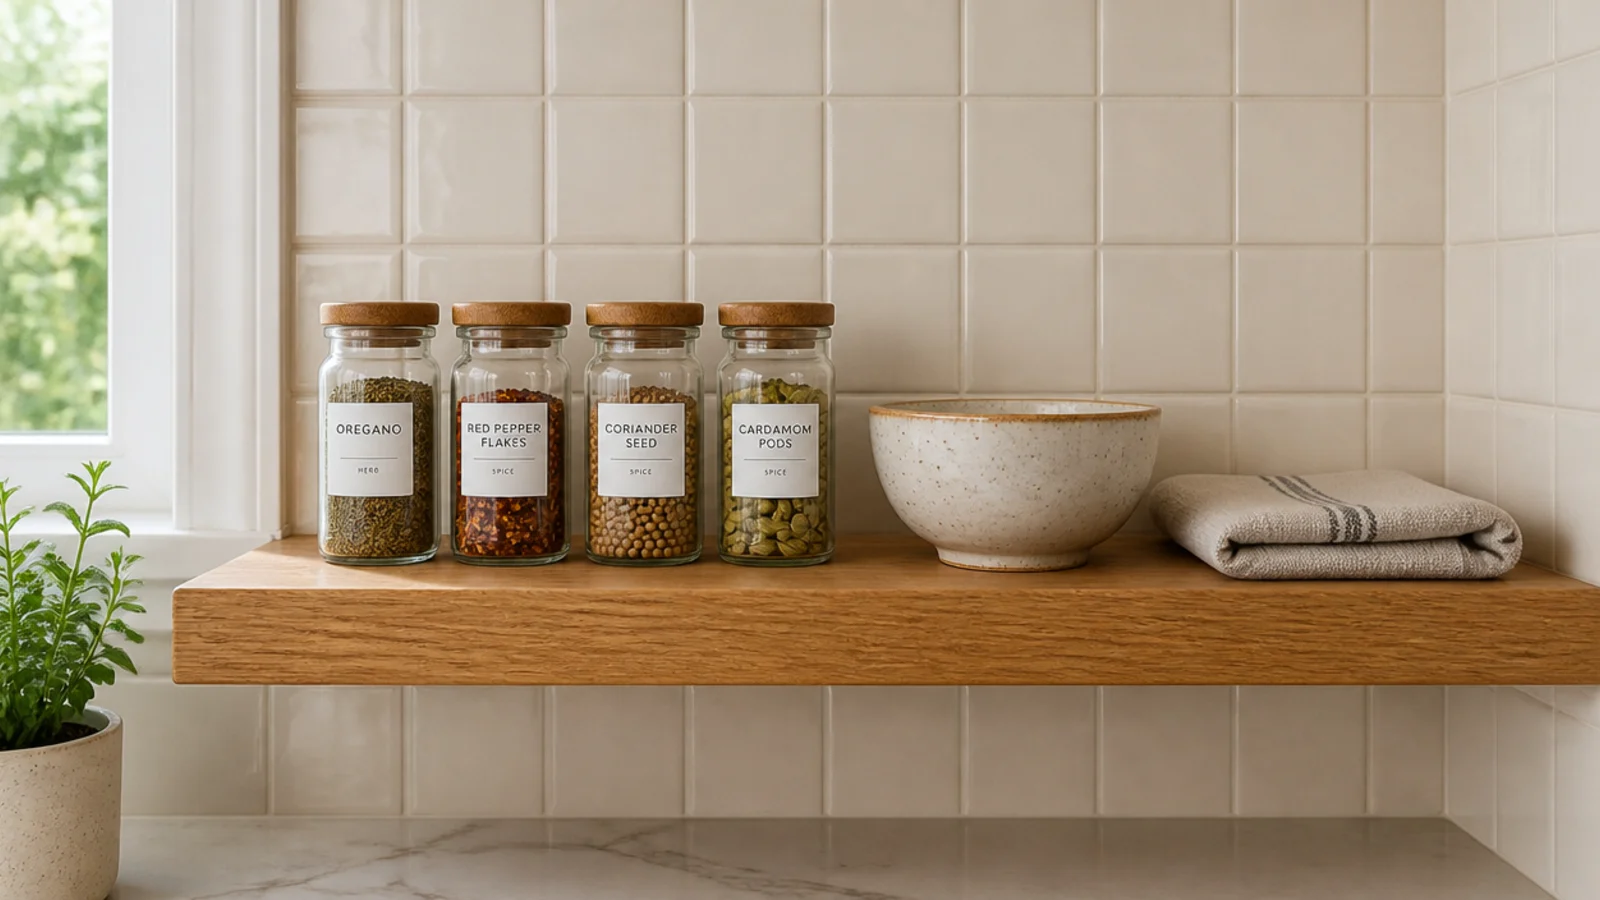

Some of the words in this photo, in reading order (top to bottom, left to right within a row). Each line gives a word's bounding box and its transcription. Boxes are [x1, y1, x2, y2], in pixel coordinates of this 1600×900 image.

[336, 423, 402, 435] OREGANO
[467, 423, 490, 434] RED
[494, 423, 541, 434] PEPPER
[605, 423, 678, 434] CORIANDER
[739, 424, 812, 435] CARDAMOM
[481, 437, 527, 448] FLAKES
[626, 438, 658, 448] SEED
[759, 438, 792, 449] PODS
